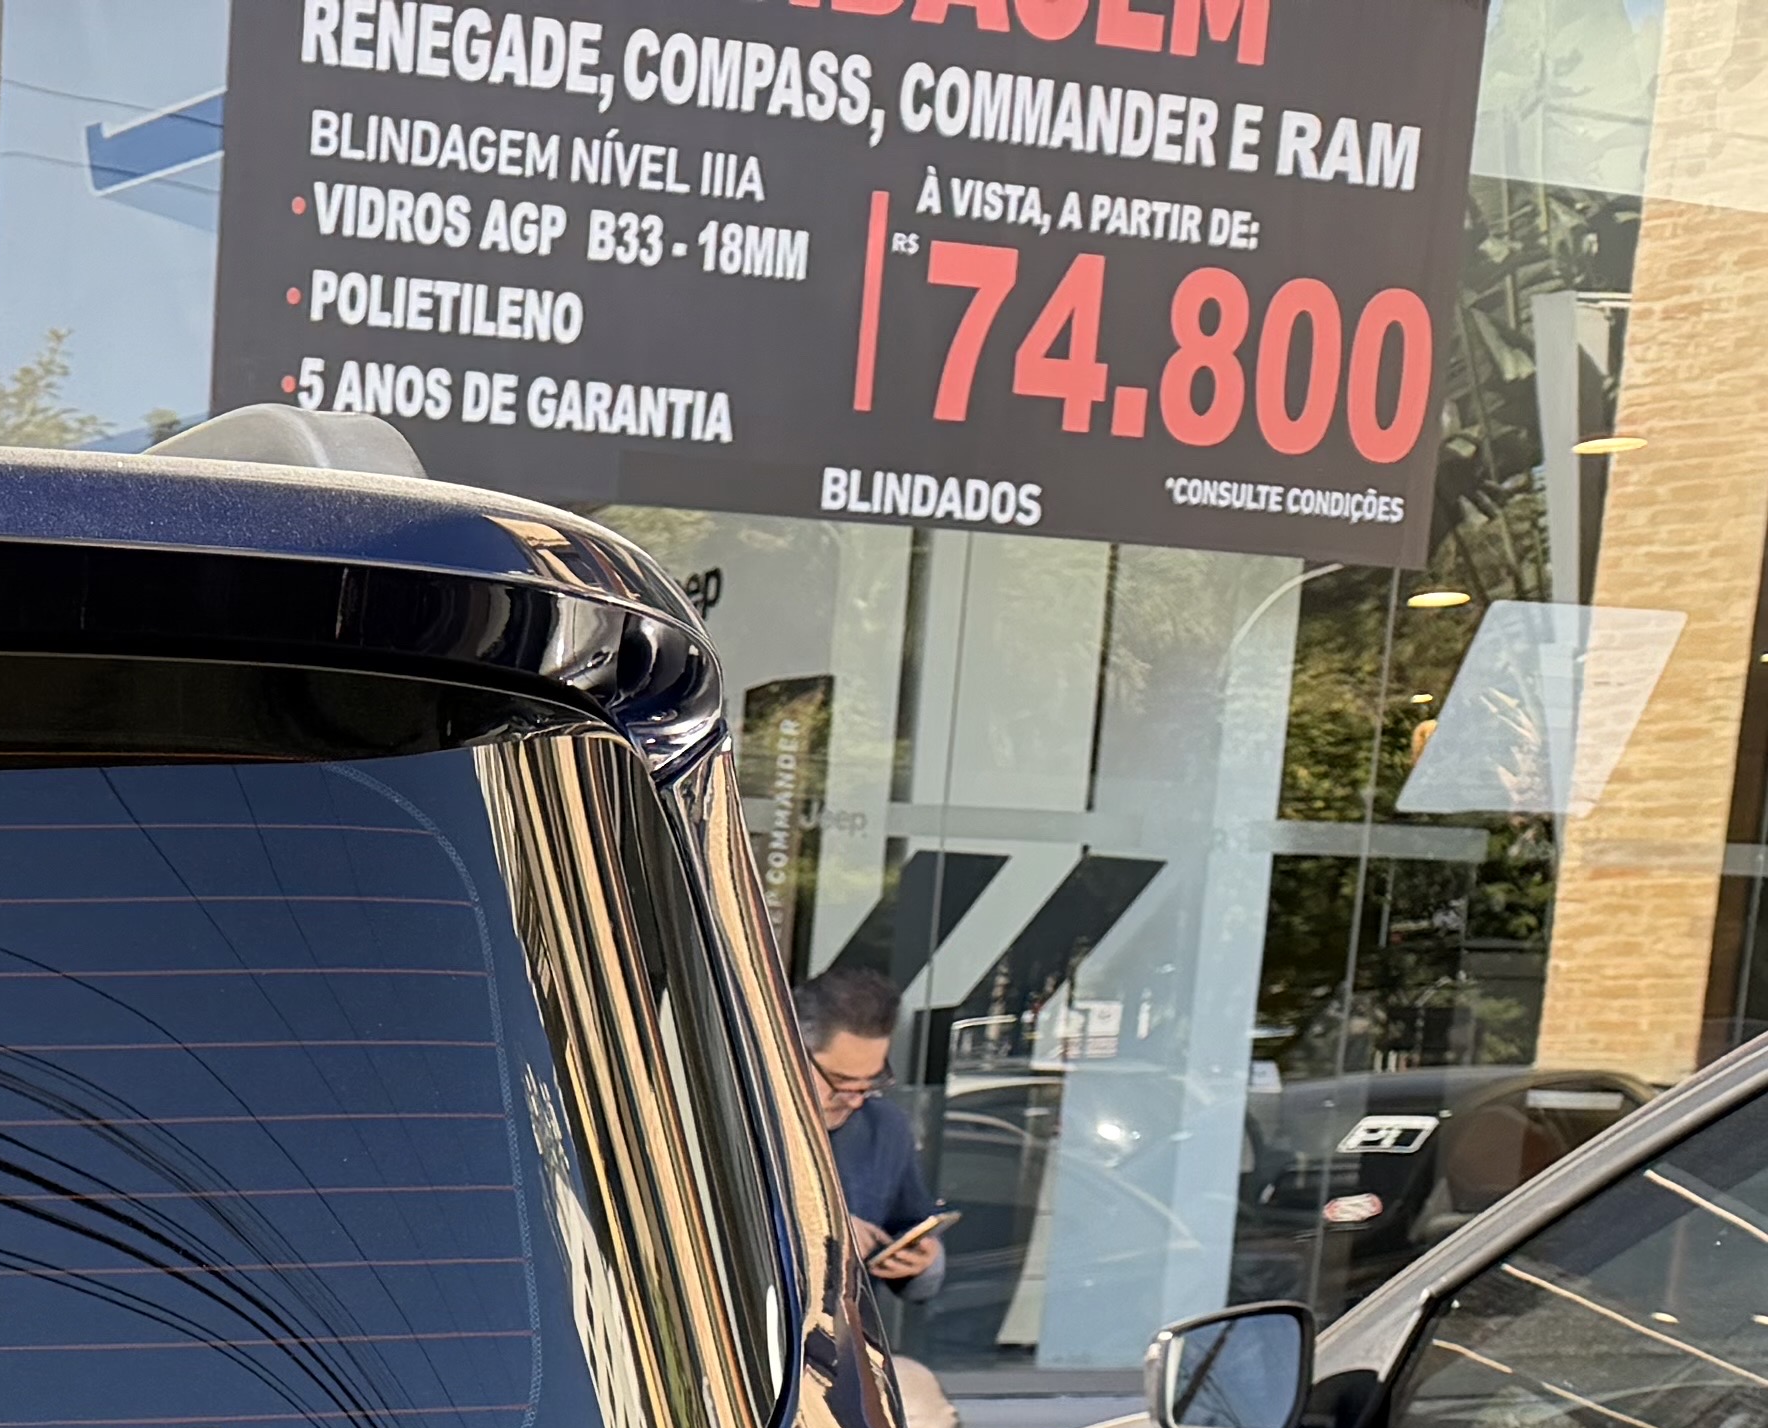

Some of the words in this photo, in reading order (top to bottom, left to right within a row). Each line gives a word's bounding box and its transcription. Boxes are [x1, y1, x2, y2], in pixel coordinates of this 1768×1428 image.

[301, 0, 614, 113] RENEGADE,
[624, 29, 885, 147] COMPASS,
[900, 62, 1219, 172] COMMANDER
[1229, 104, 1263, 171] E
[1276, 111, 1421, 190] RAM
[310, 110, 560, 180] BLINDAGEM
[571, 129, 690, 193] NÍVEL
[701, 152, 764, 201] IIIA
[314, 182, 471, 247] VIDROS
[479, 199, 566, 255] AGP
[587, 210, 663, 266] B33
[698, 221, 809, 280] 18MM
[917, 166, 941, 214] À
[951, 178, 1051, 234] VISTA,
[1058, 192, 1082, 230] A
[1090, 195, 1202, 243] PARTIR
[1208, 208, 1259, 249] DE:
[310, 270, 583, 344] POLIETILENO
[892, 233, 919, 254] R$
[928, 241, 1433, 463] 74.800
[298, 358, 325, 411] 5
[333, 362, 452, 420] ANOS
[462, 371, 518, 424] DE
[527, 377, 732, 443] GARANTIA
[821, 468, 1041, 525] BLINDADOS
[1287, 488, 1403, 522] CONDIÇÕES
[765, 718, 800, 885] COMMANDER
